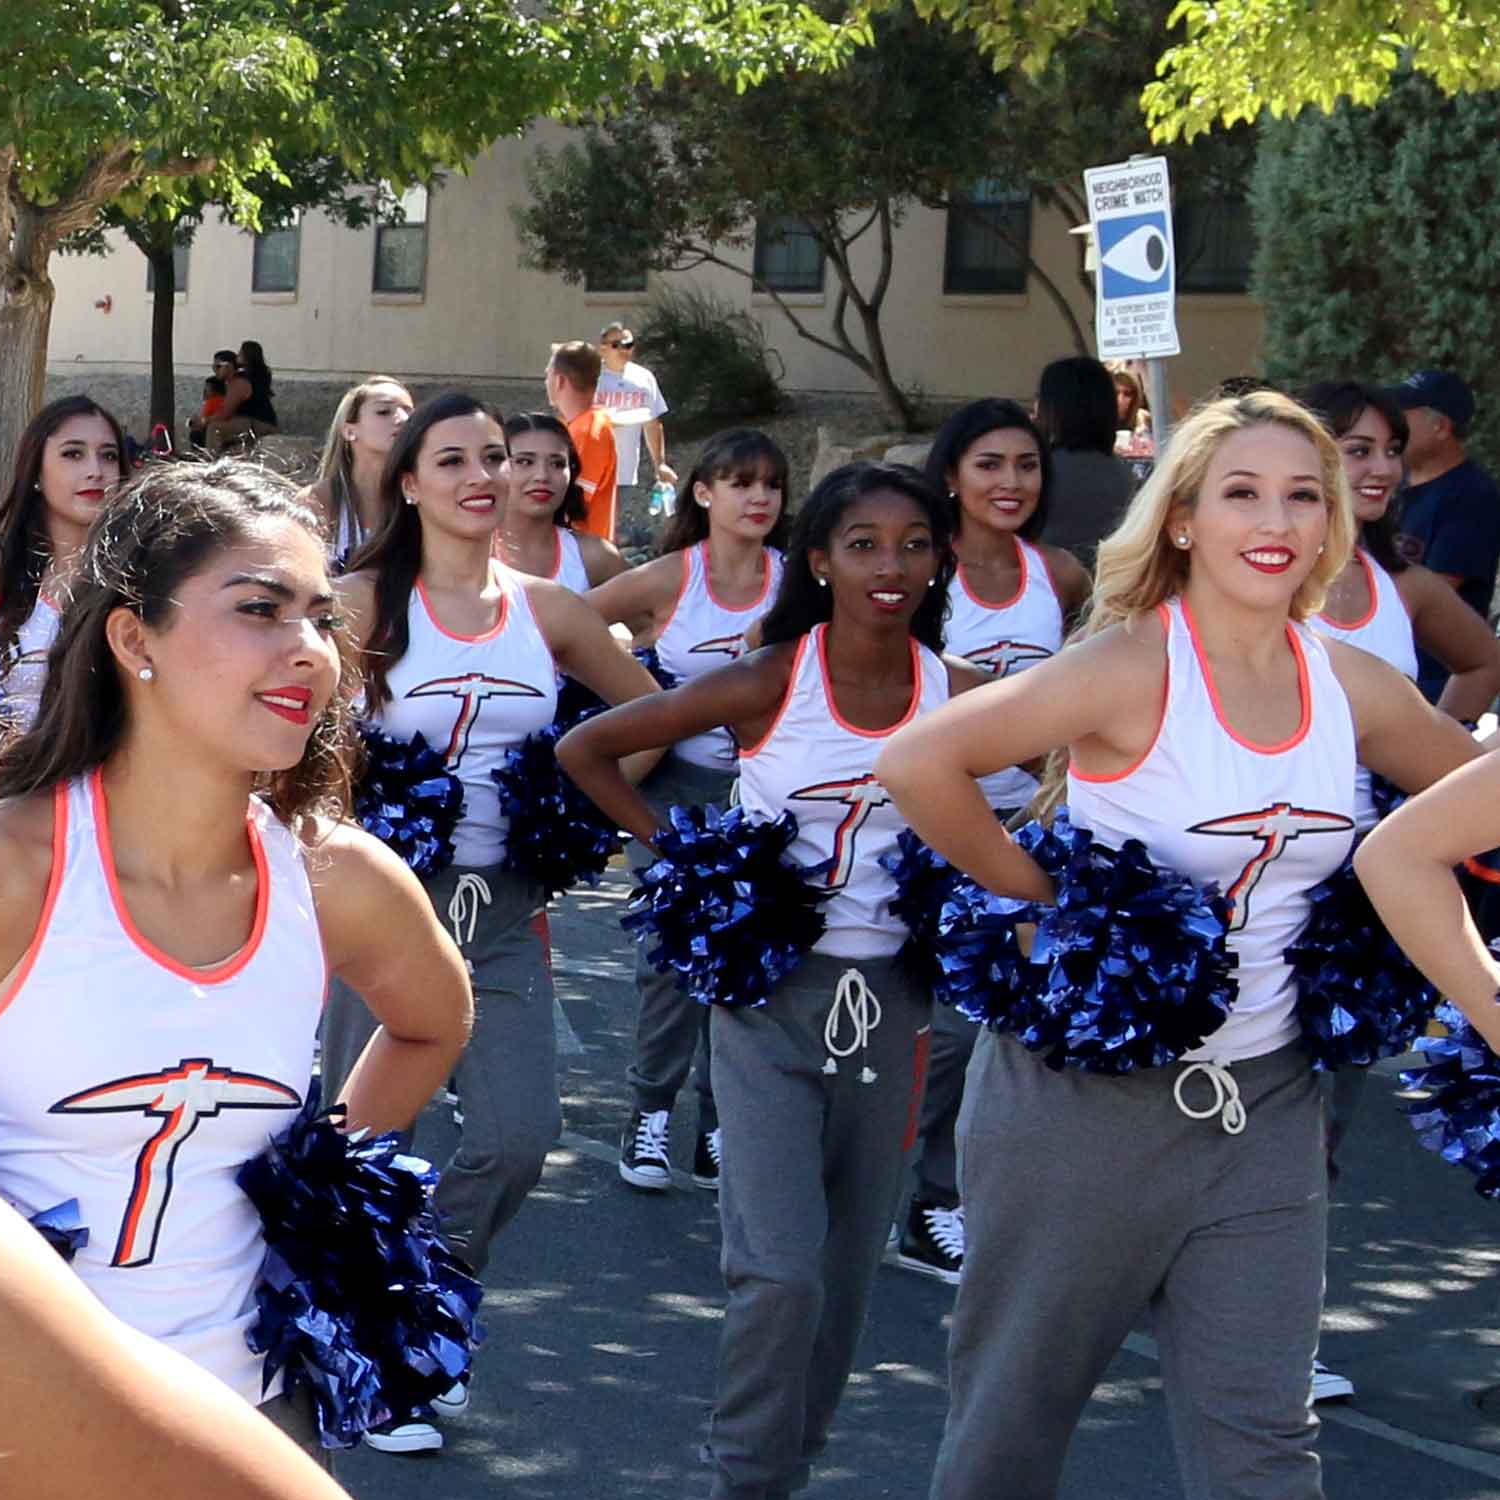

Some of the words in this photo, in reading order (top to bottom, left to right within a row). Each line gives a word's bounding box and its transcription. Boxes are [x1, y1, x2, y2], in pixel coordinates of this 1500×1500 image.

[1093, 172, 1162, 194] NEIGHBORHOOD
[1095, 193, 1129, 211] CRIME
[1133, 187, 1164, 205] WATCH
